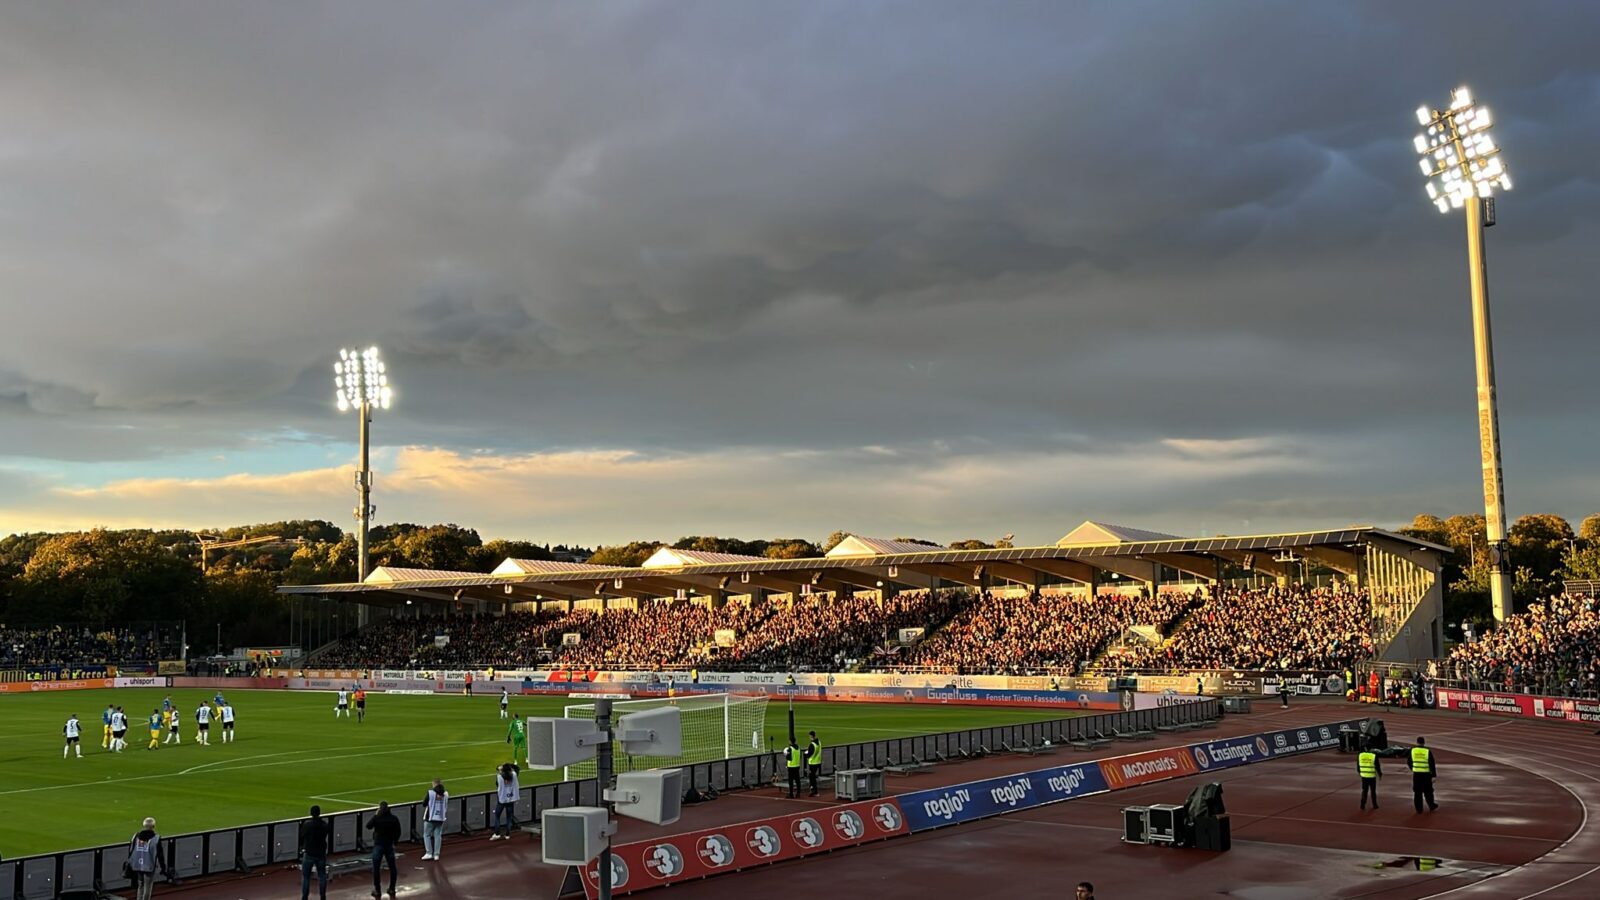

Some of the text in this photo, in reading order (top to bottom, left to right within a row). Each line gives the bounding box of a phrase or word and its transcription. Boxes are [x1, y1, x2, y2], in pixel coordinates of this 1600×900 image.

[776, 686, 818, 699] Gugelfuss
[928, 688, 1066, 704] Gugelfuss Fenster Türen Fassaden
[1477, 703, 1490, 712] TEAM
[1566, 712, 1580, 721] TEAM
[1208, 743, 1255, 762] Ensinger
[1122, 757, 1178, 779] McDonald's
[840, 814, 857, 836] 3
[879, 806, 895, 828] 3
[754, 830, 772, 854] 3
[799, 822, 816, 845] 3
[653, 848, 674, 874] 3
[706, 838, 725, 864] 3
